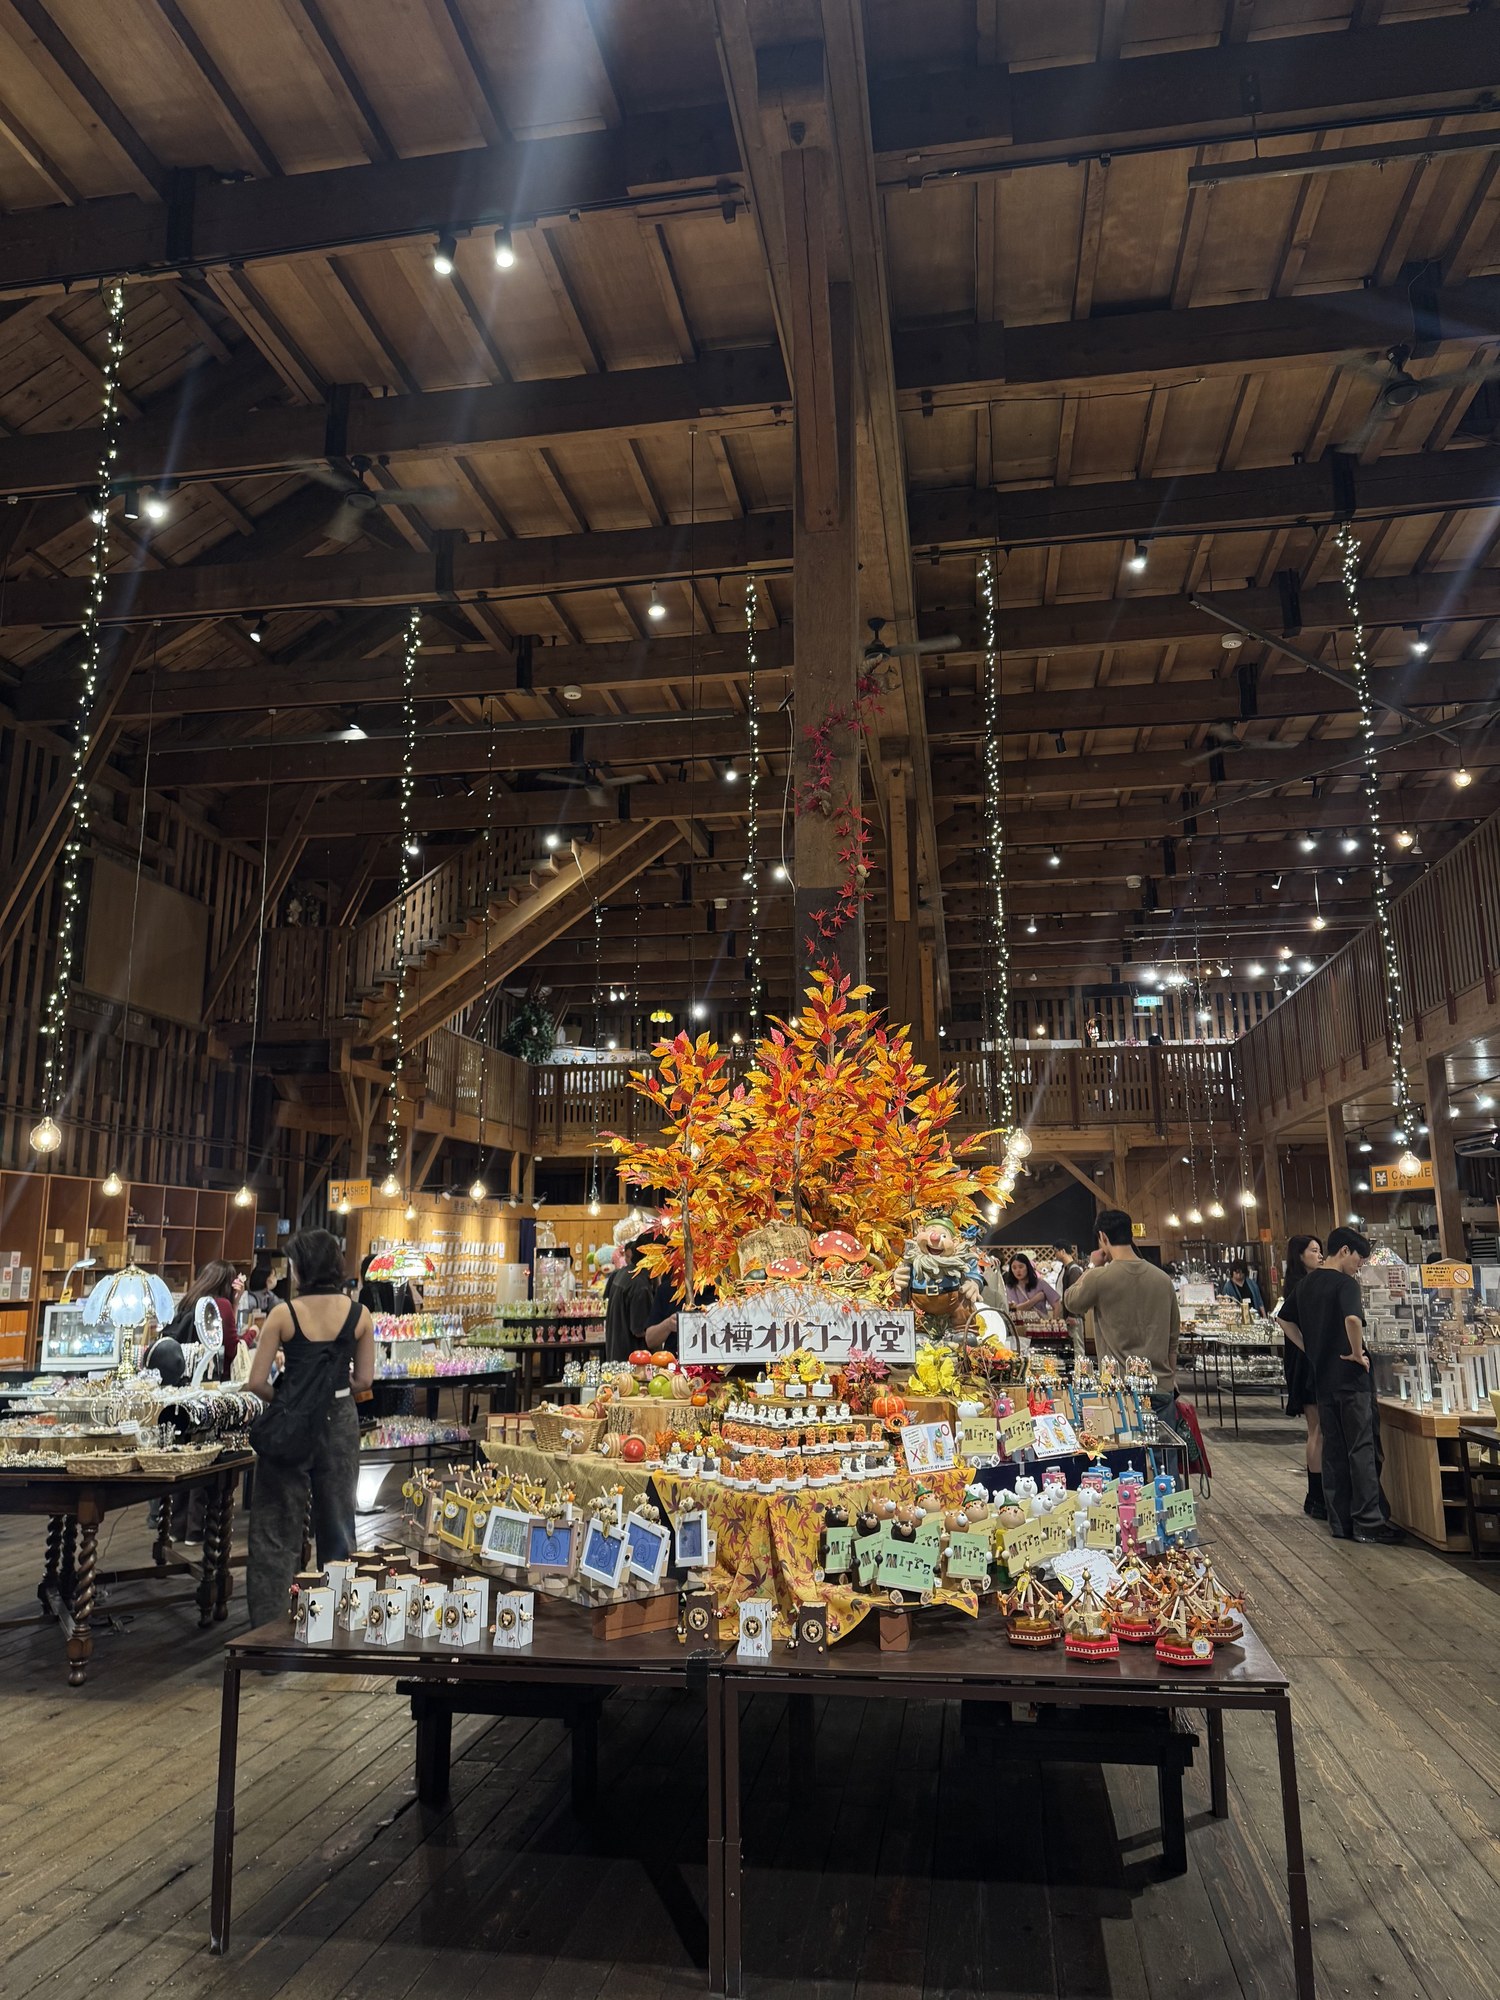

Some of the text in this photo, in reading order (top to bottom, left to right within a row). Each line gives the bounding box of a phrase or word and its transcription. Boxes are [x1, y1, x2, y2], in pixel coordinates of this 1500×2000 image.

[689, 1321, 905, 1354] 小樽オルゴール堂
